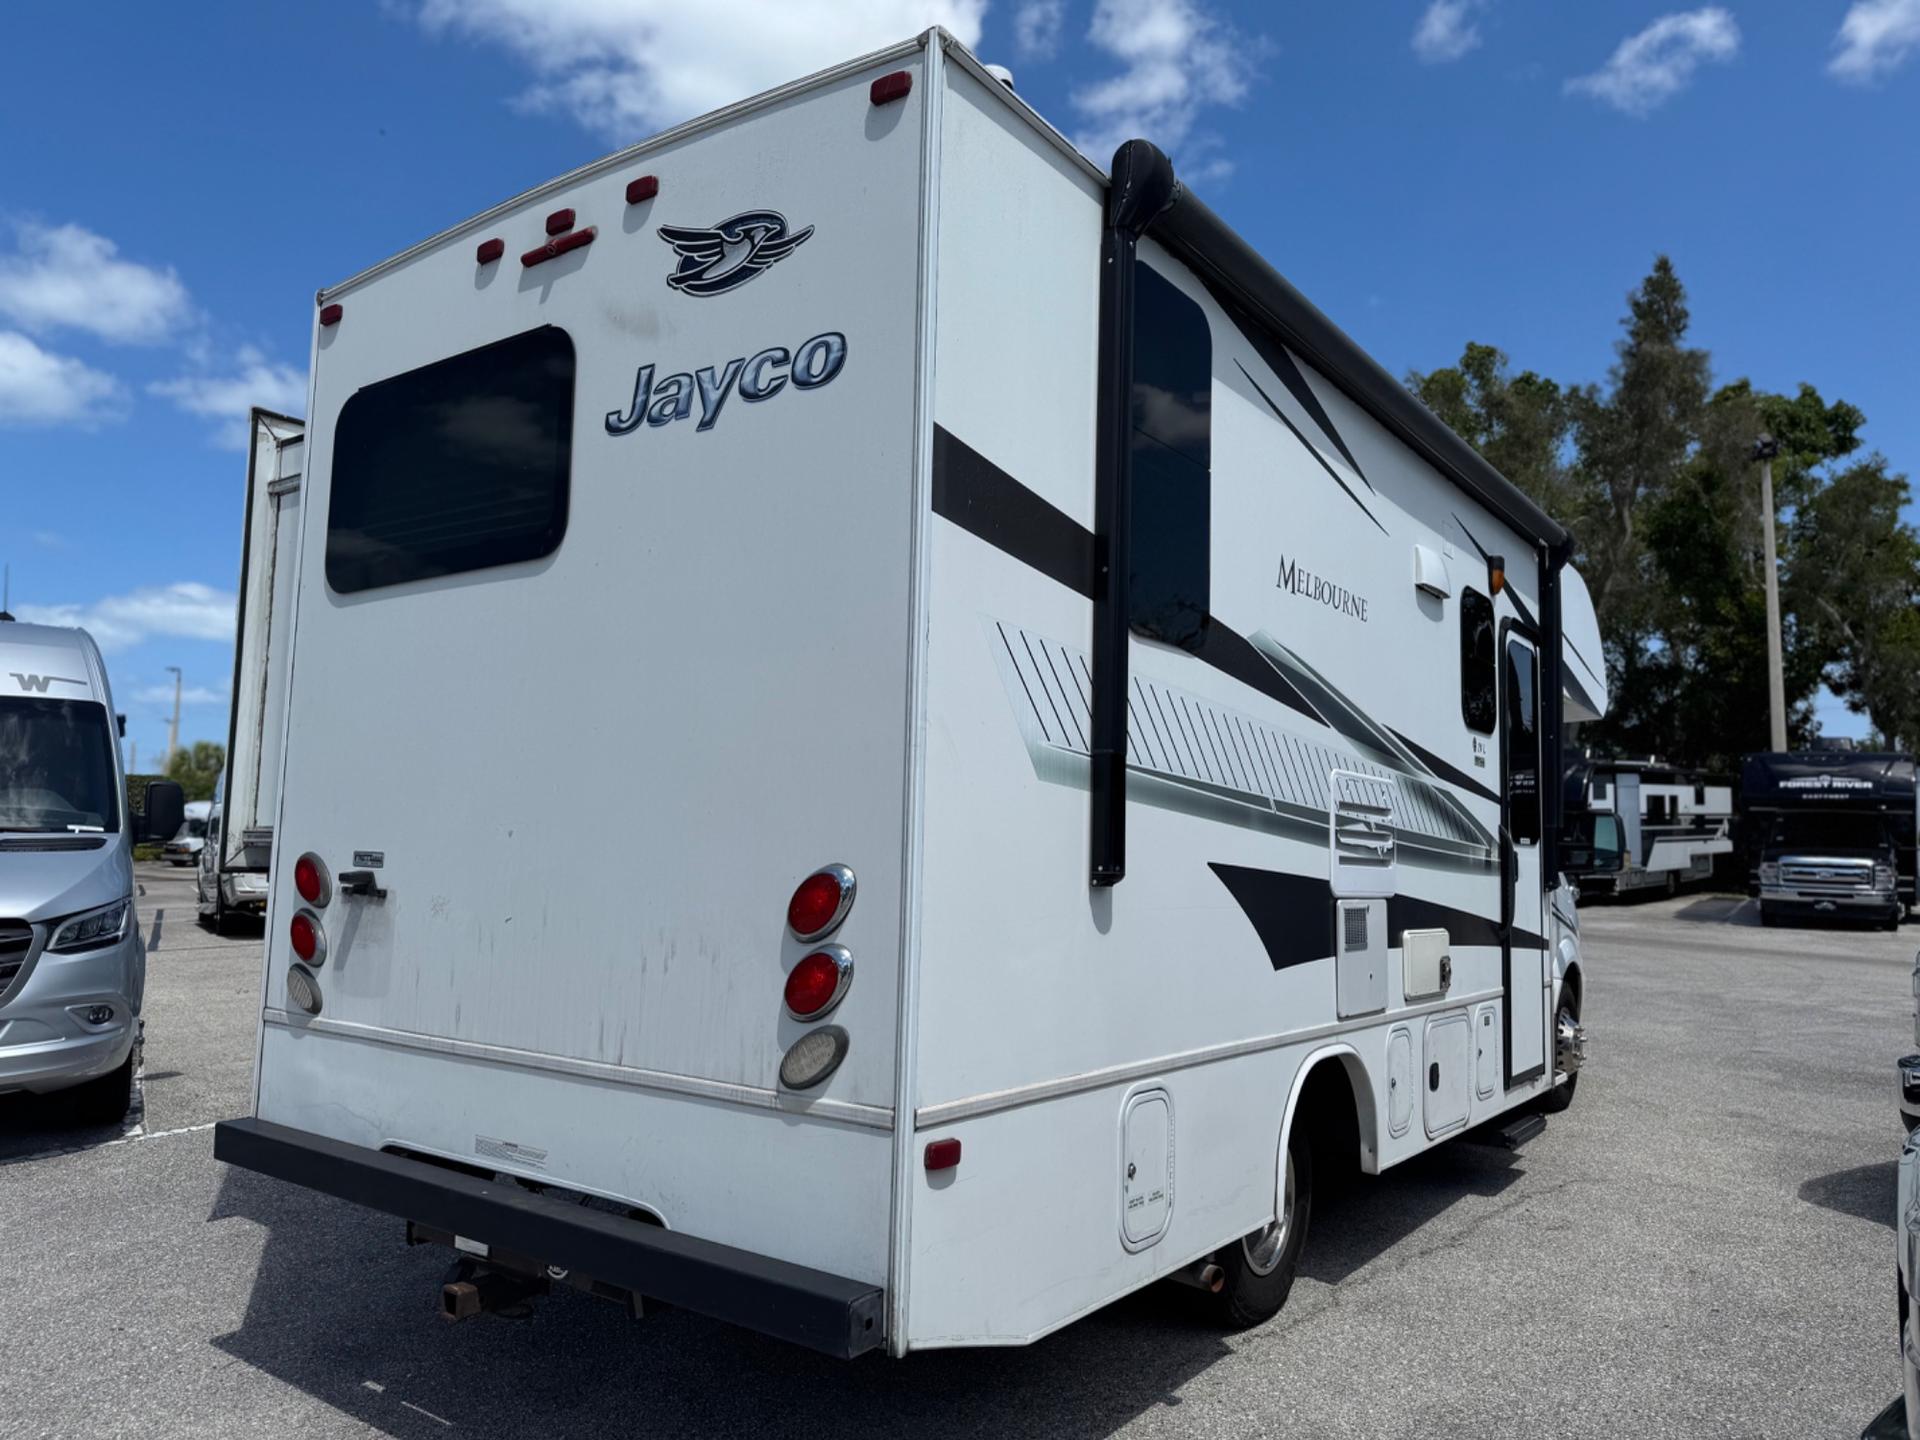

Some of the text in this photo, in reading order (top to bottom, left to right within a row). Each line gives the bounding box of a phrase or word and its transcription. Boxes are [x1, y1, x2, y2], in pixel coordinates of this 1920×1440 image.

[605, 331, 848, 437] Jayco
[1276, 553, 1368, 622] MELBOURNE
[1779, 780, 1873, 789] FOREST RIVER
